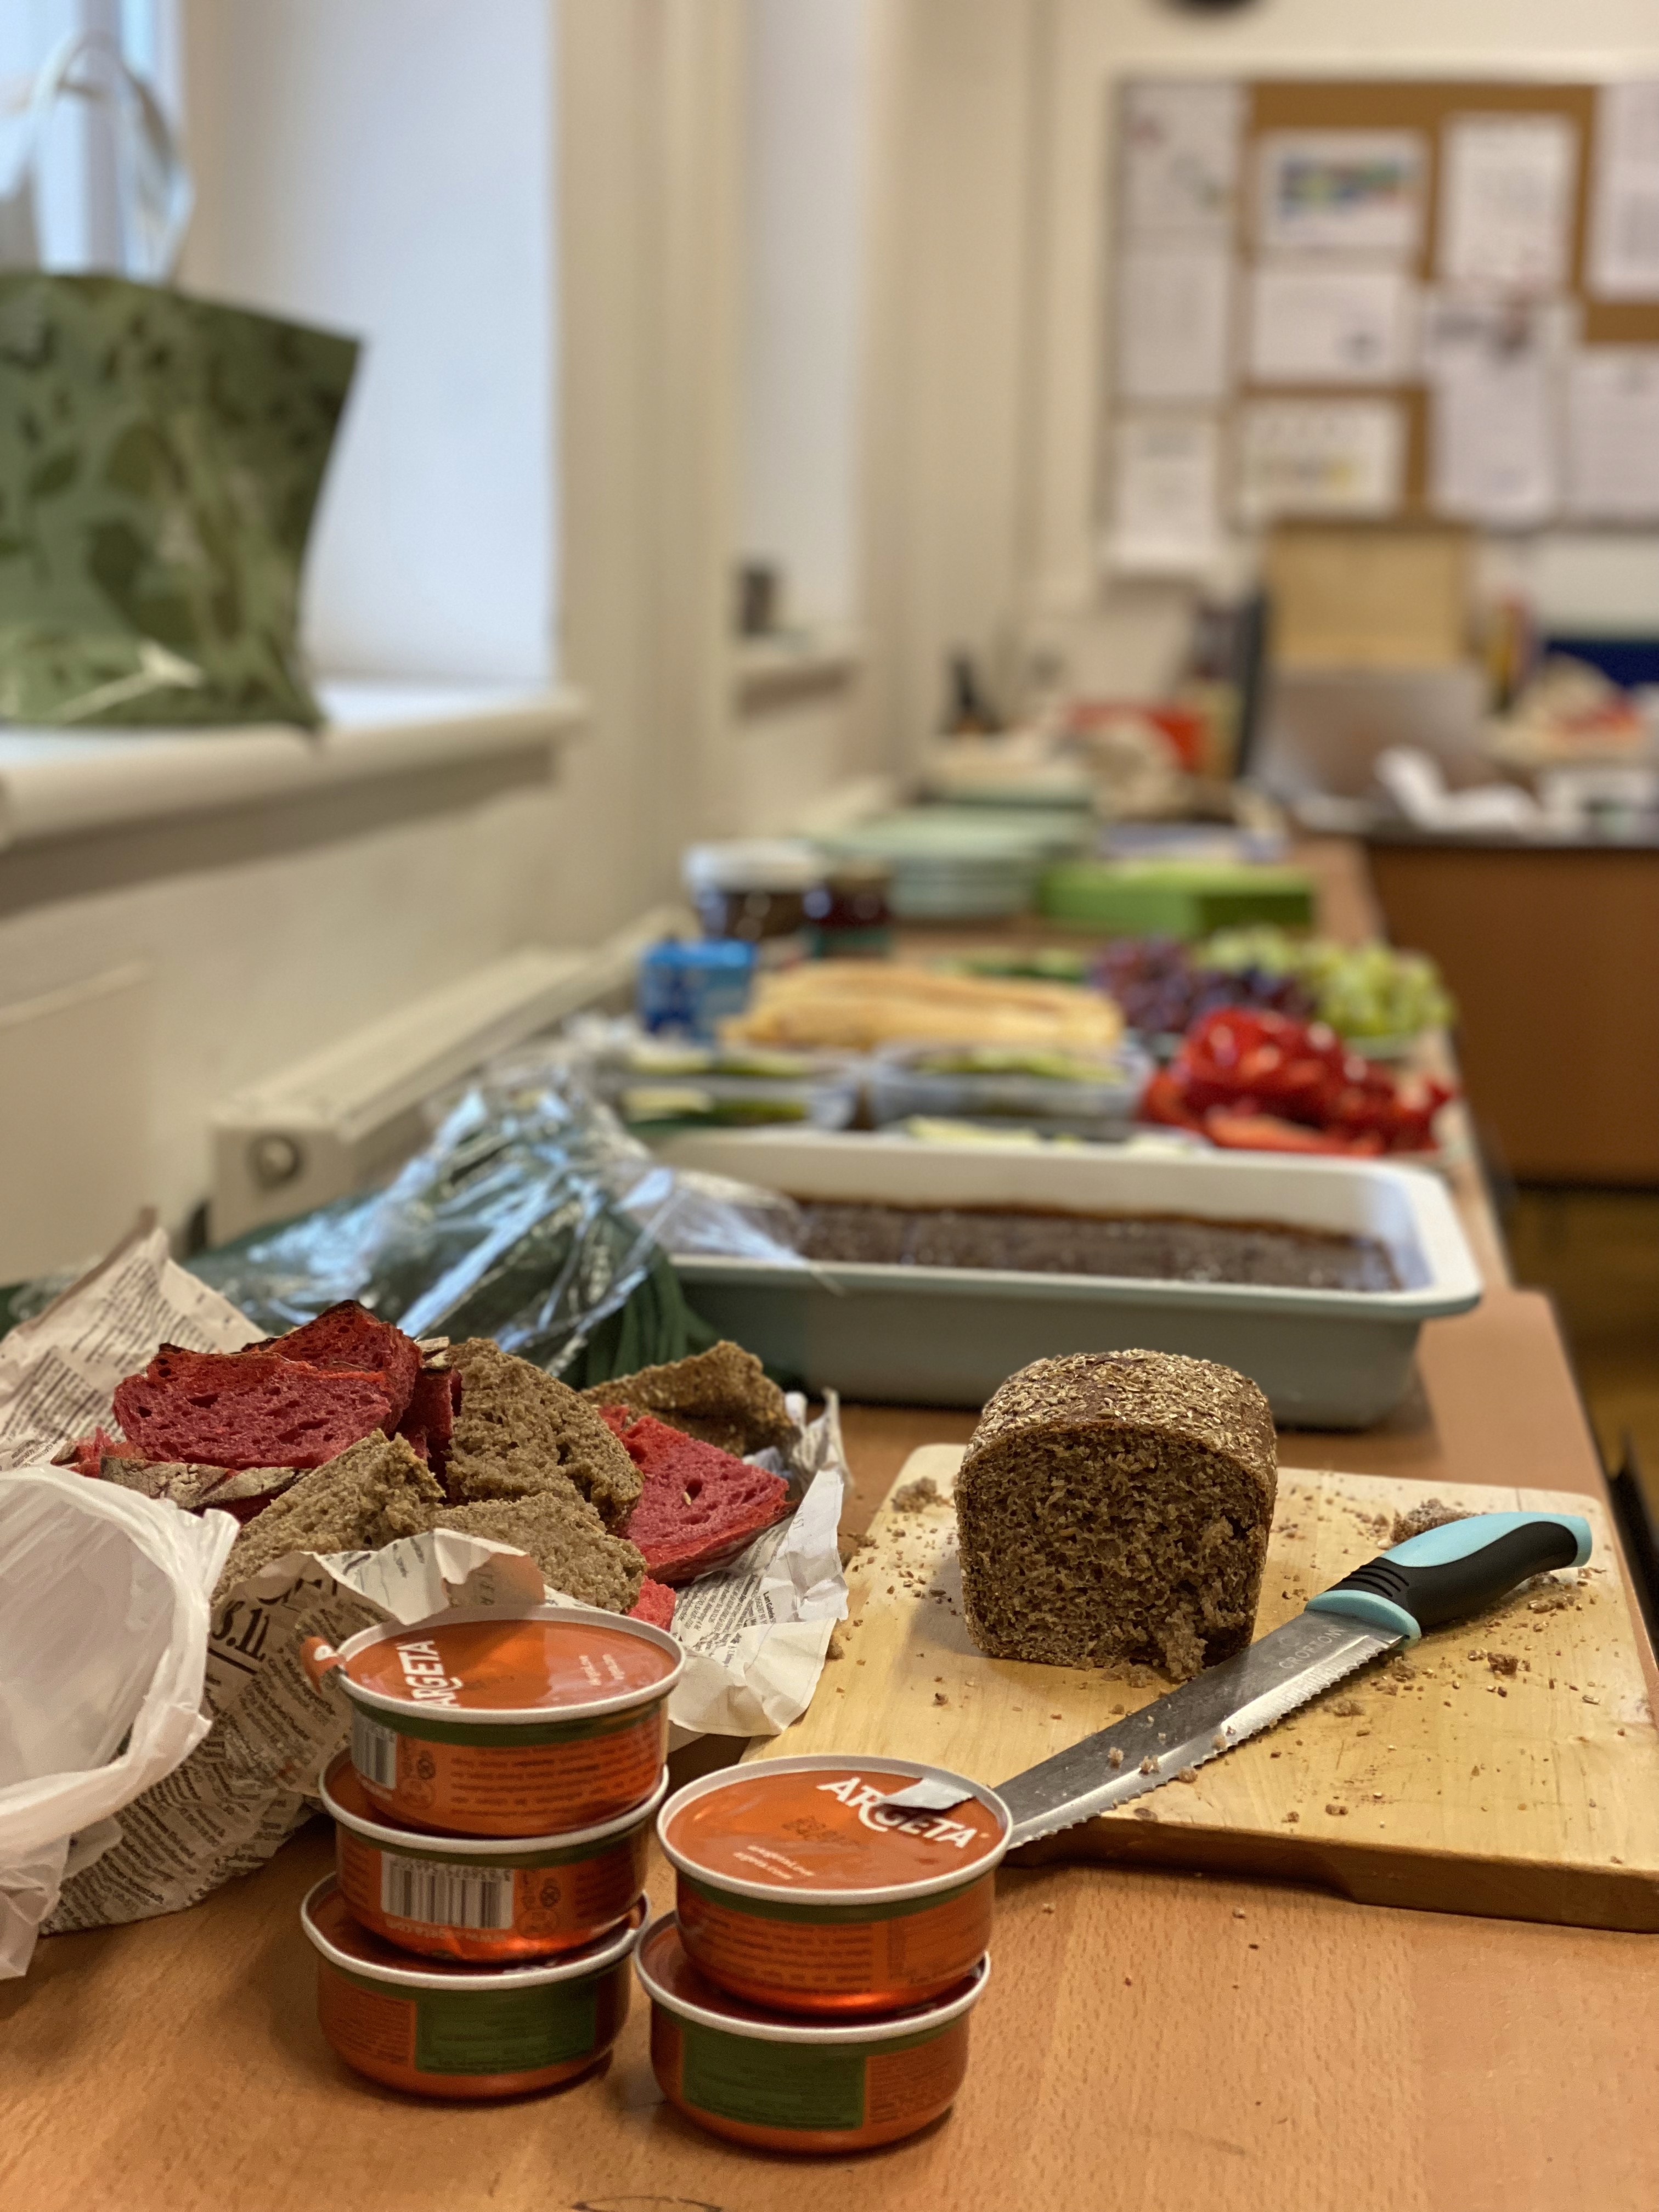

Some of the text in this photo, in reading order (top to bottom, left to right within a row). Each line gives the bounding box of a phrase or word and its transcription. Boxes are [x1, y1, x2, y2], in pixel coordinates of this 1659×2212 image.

[396, 1640, 463, 1707] ARGETA
[1279, 1626, 1345, 1668] CROFTON
[816, 1776, 978, 1848] ARGETA
